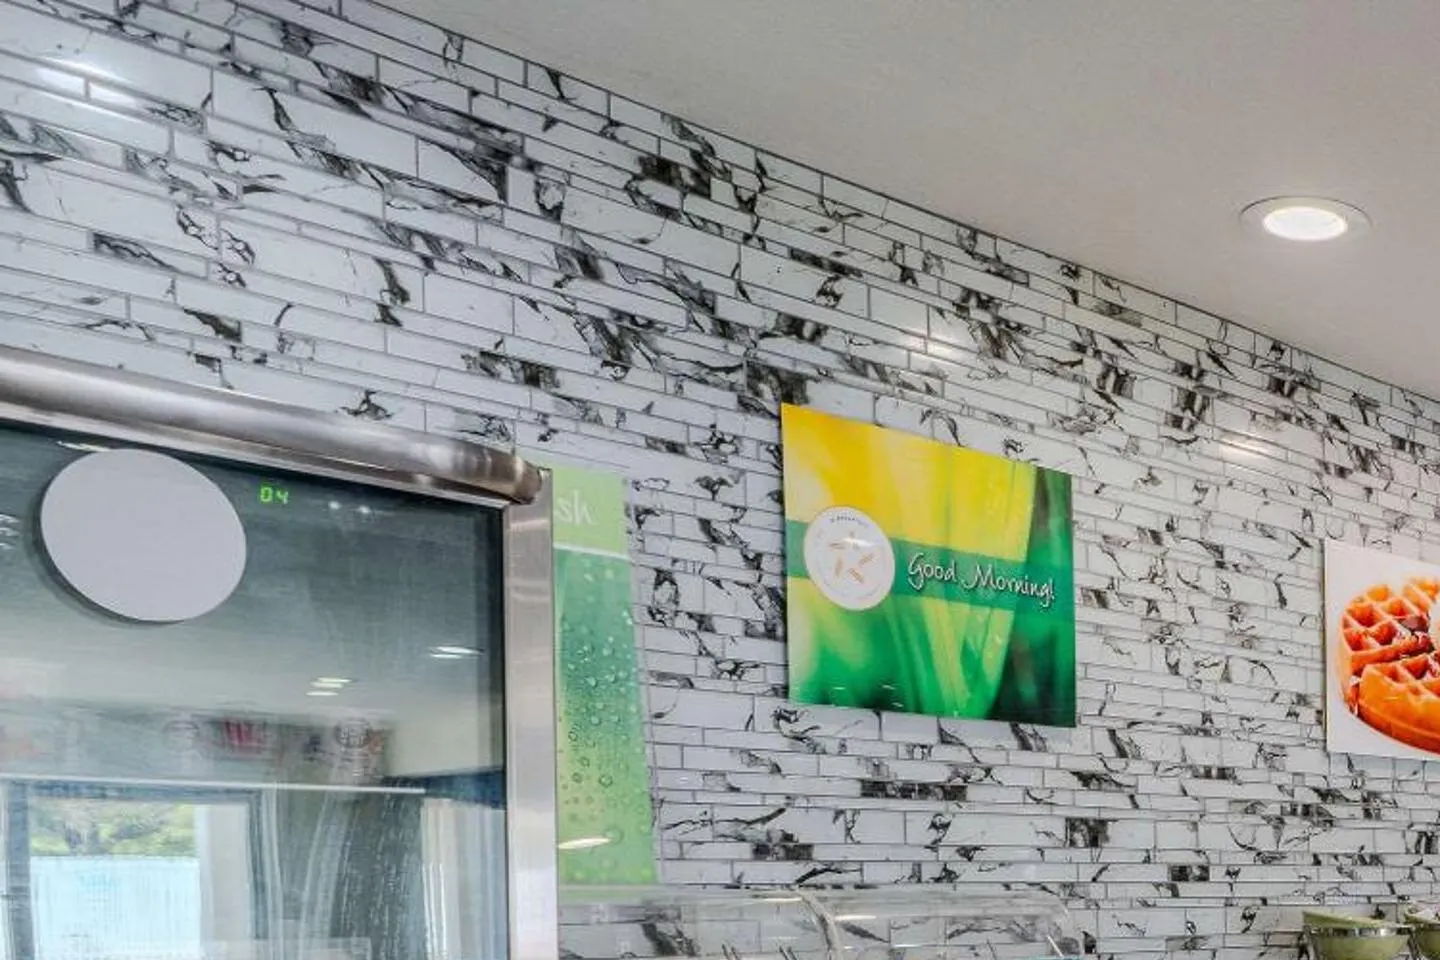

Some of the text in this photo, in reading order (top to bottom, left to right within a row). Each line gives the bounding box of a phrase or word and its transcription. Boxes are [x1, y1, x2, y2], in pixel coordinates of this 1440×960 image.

[260, 486, 289, 505] 04
[907, 552, 1055, 608] Good Morning!
